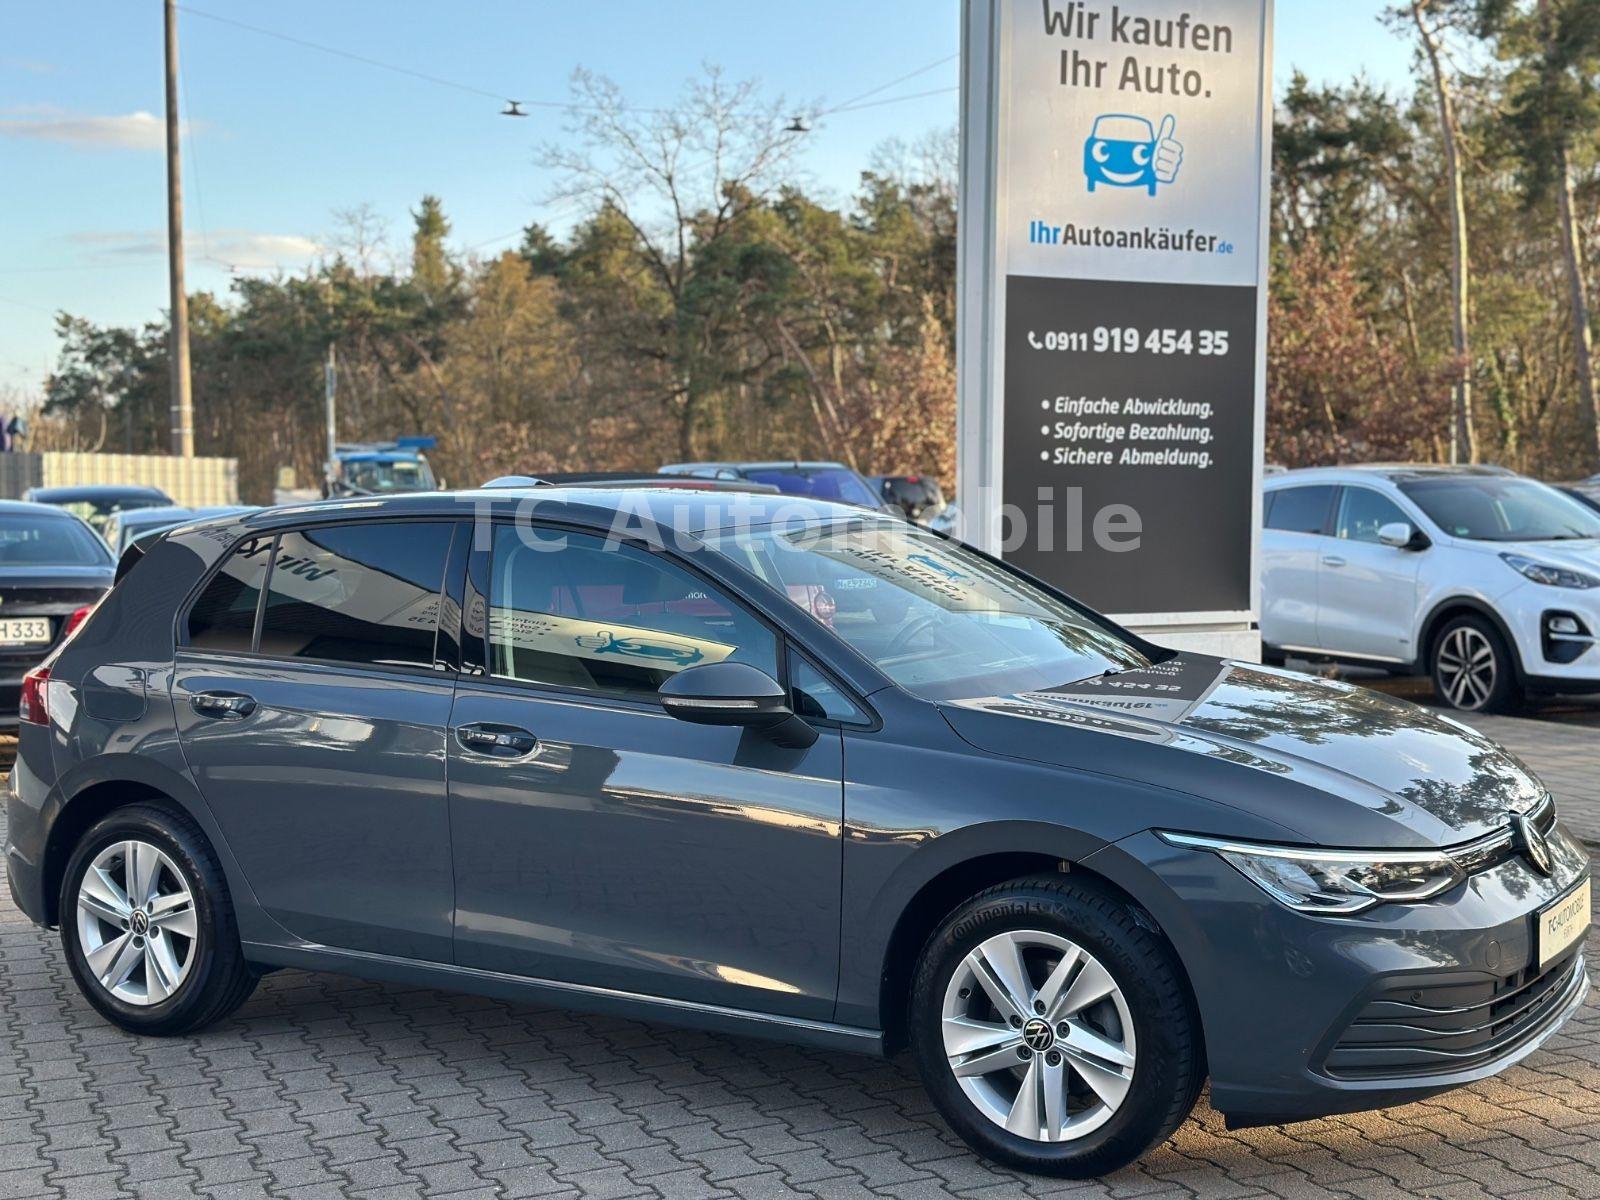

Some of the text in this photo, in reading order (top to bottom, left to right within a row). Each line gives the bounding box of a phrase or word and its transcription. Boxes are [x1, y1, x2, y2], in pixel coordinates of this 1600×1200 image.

[1043, 0, 1232, 53] Wir kaufen
[1060, 50, 1212, 98] Ihr Auto.
[1045, 326, 1229, 356] 0911 919 454 35
[1055, 396, 1214, 419] Einfache Abwicklung.
[1054, 421, 1214, 444] Sofortige Bezahlung.
[1053, 447, 1214, 468] Sichere Abmeldung.
[12, 622, 45, 638] 333
[953, 902, 1031, 940] Continental
